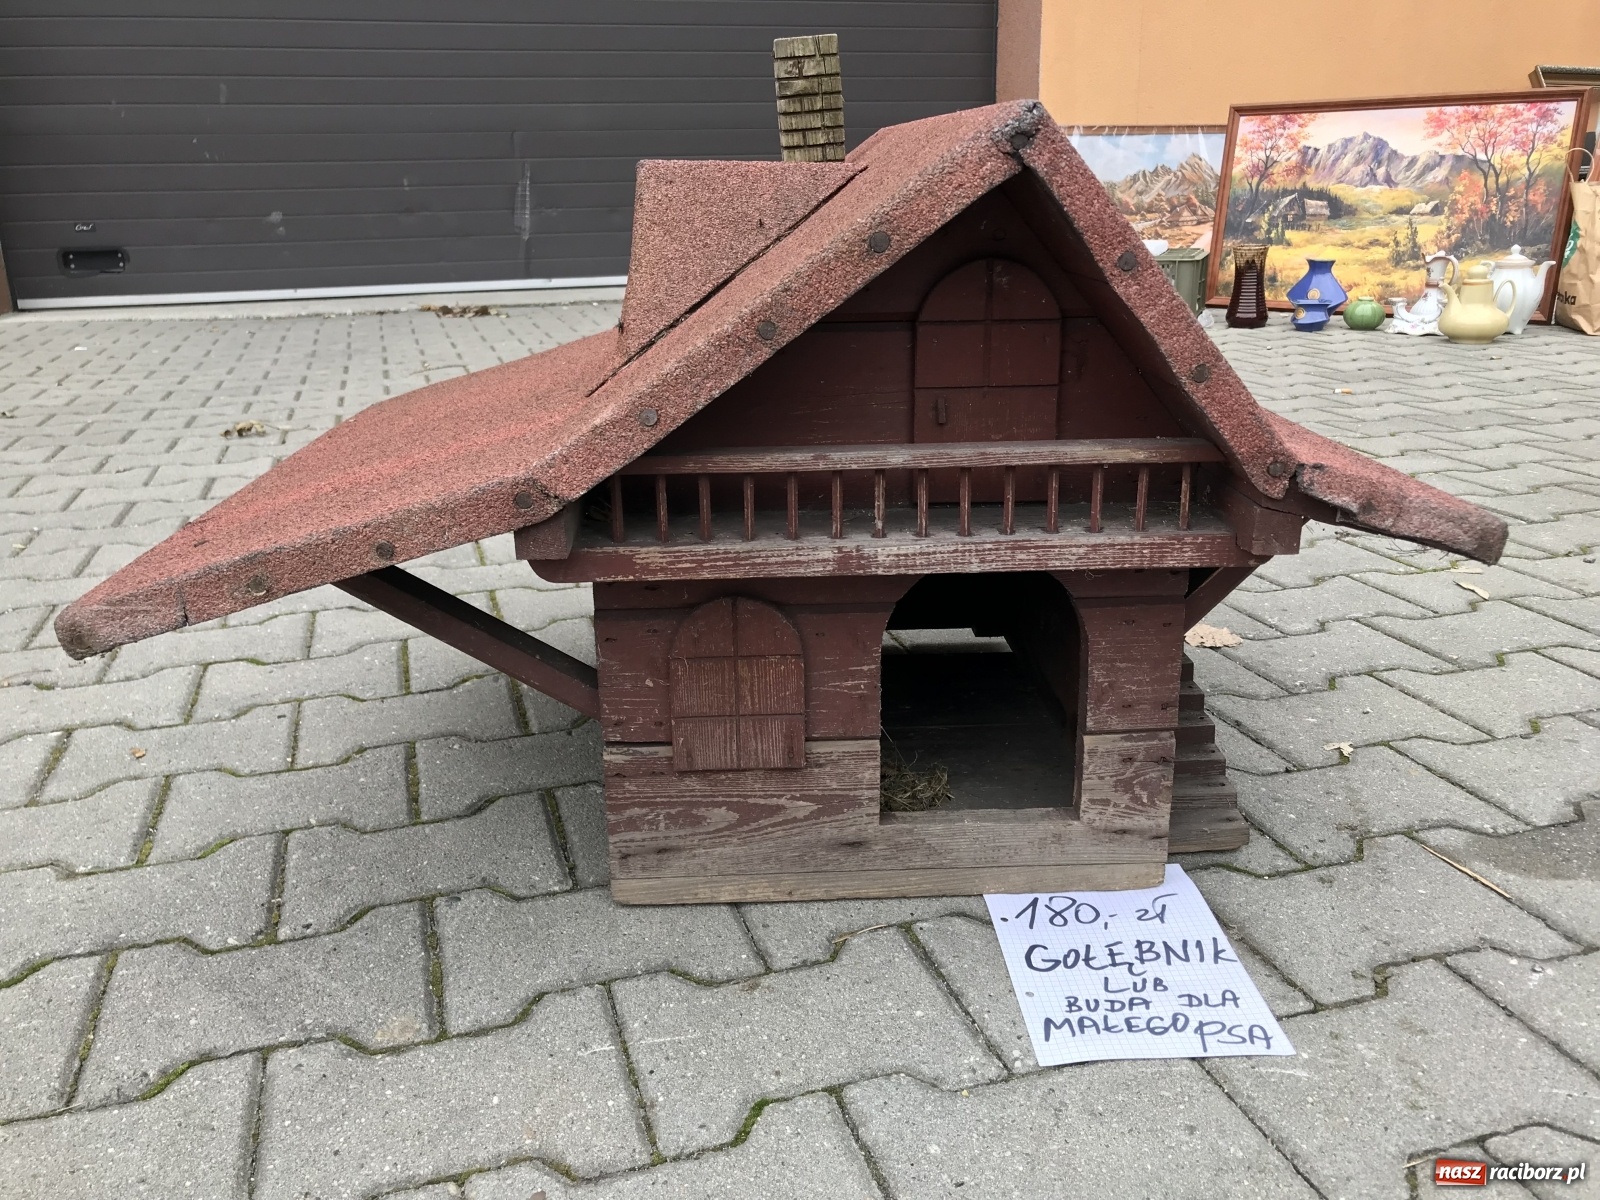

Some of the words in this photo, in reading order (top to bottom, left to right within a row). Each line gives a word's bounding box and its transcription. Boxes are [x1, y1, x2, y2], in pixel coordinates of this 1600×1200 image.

[1024, 937, 1239, 976] GOŁĘBNIK
[1103, 977, 1169, 993] LUB
[1065, 996, 1153, 1013] BUDA
[1178, 989, 1241, 1008] DLA
[1043, 1012, 1190, 1042] MAŁEGO
[1193, 1019, 1273, 1053] PSA
